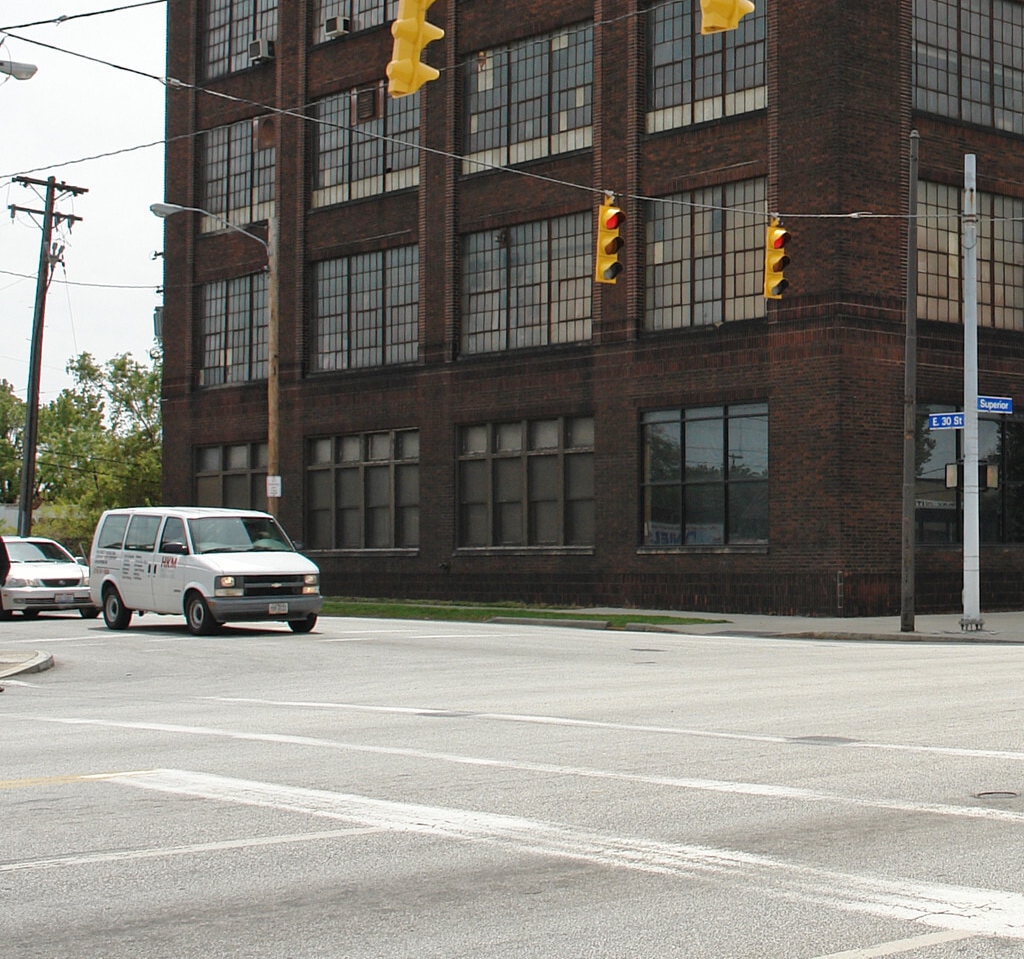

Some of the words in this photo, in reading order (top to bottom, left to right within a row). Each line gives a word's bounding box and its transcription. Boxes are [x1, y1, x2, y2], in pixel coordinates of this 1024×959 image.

[980, 399, 1009, 411] Superior
[941, 416, 952, 426] 30
[953, 415, 963, 425] St
[161, 556, 178, 568] HKM
